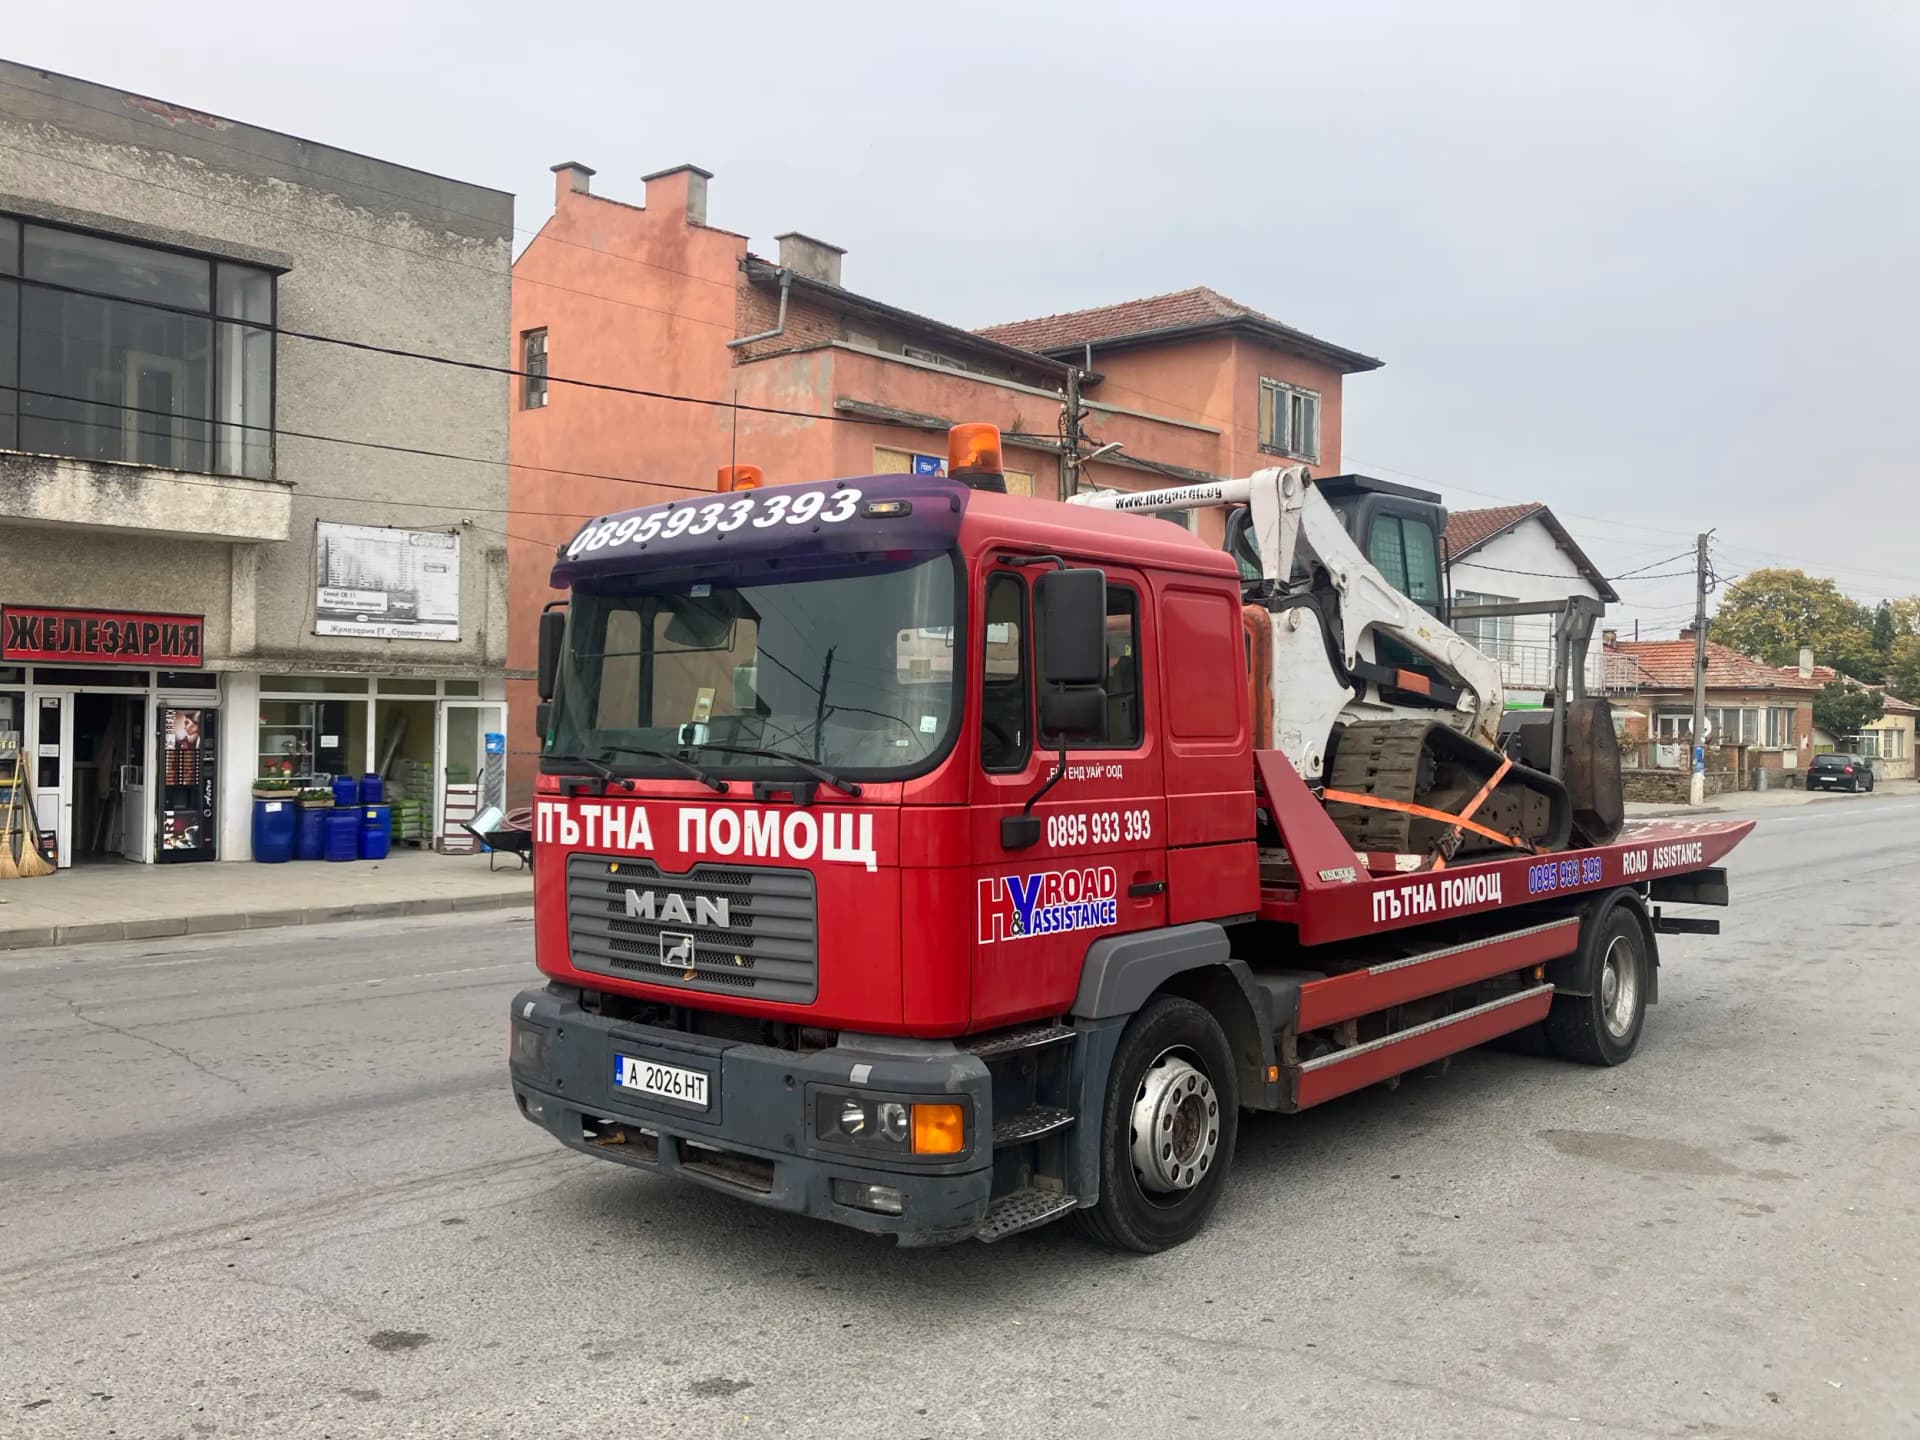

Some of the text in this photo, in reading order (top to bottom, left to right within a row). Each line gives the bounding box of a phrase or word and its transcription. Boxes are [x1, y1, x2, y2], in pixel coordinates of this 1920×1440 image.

[7, 615, 200, 656] ЖЕЛЕЗАРИЯ
[1068, 766, 1085, 782] ЕНД
[1106, 764, 1123, 779] ООД
[536, 802, 877, 872] ПЪТНА ПОМОЩ
[1047, 809, 1151, 848] 0895 933 393
[1528, 856, 1602, 894] 0895 933 393
[1624, 842, 1702, 875] ROAD ASSISTANCE
[1042, 866, 1117, 907] ROAD
[1373, 872, 1502, 922] ПЪТНА ПОМОЩ
[625, 889, 730, 928] MAN
[1030, 899, 1117, 935] ASSISTANCE
